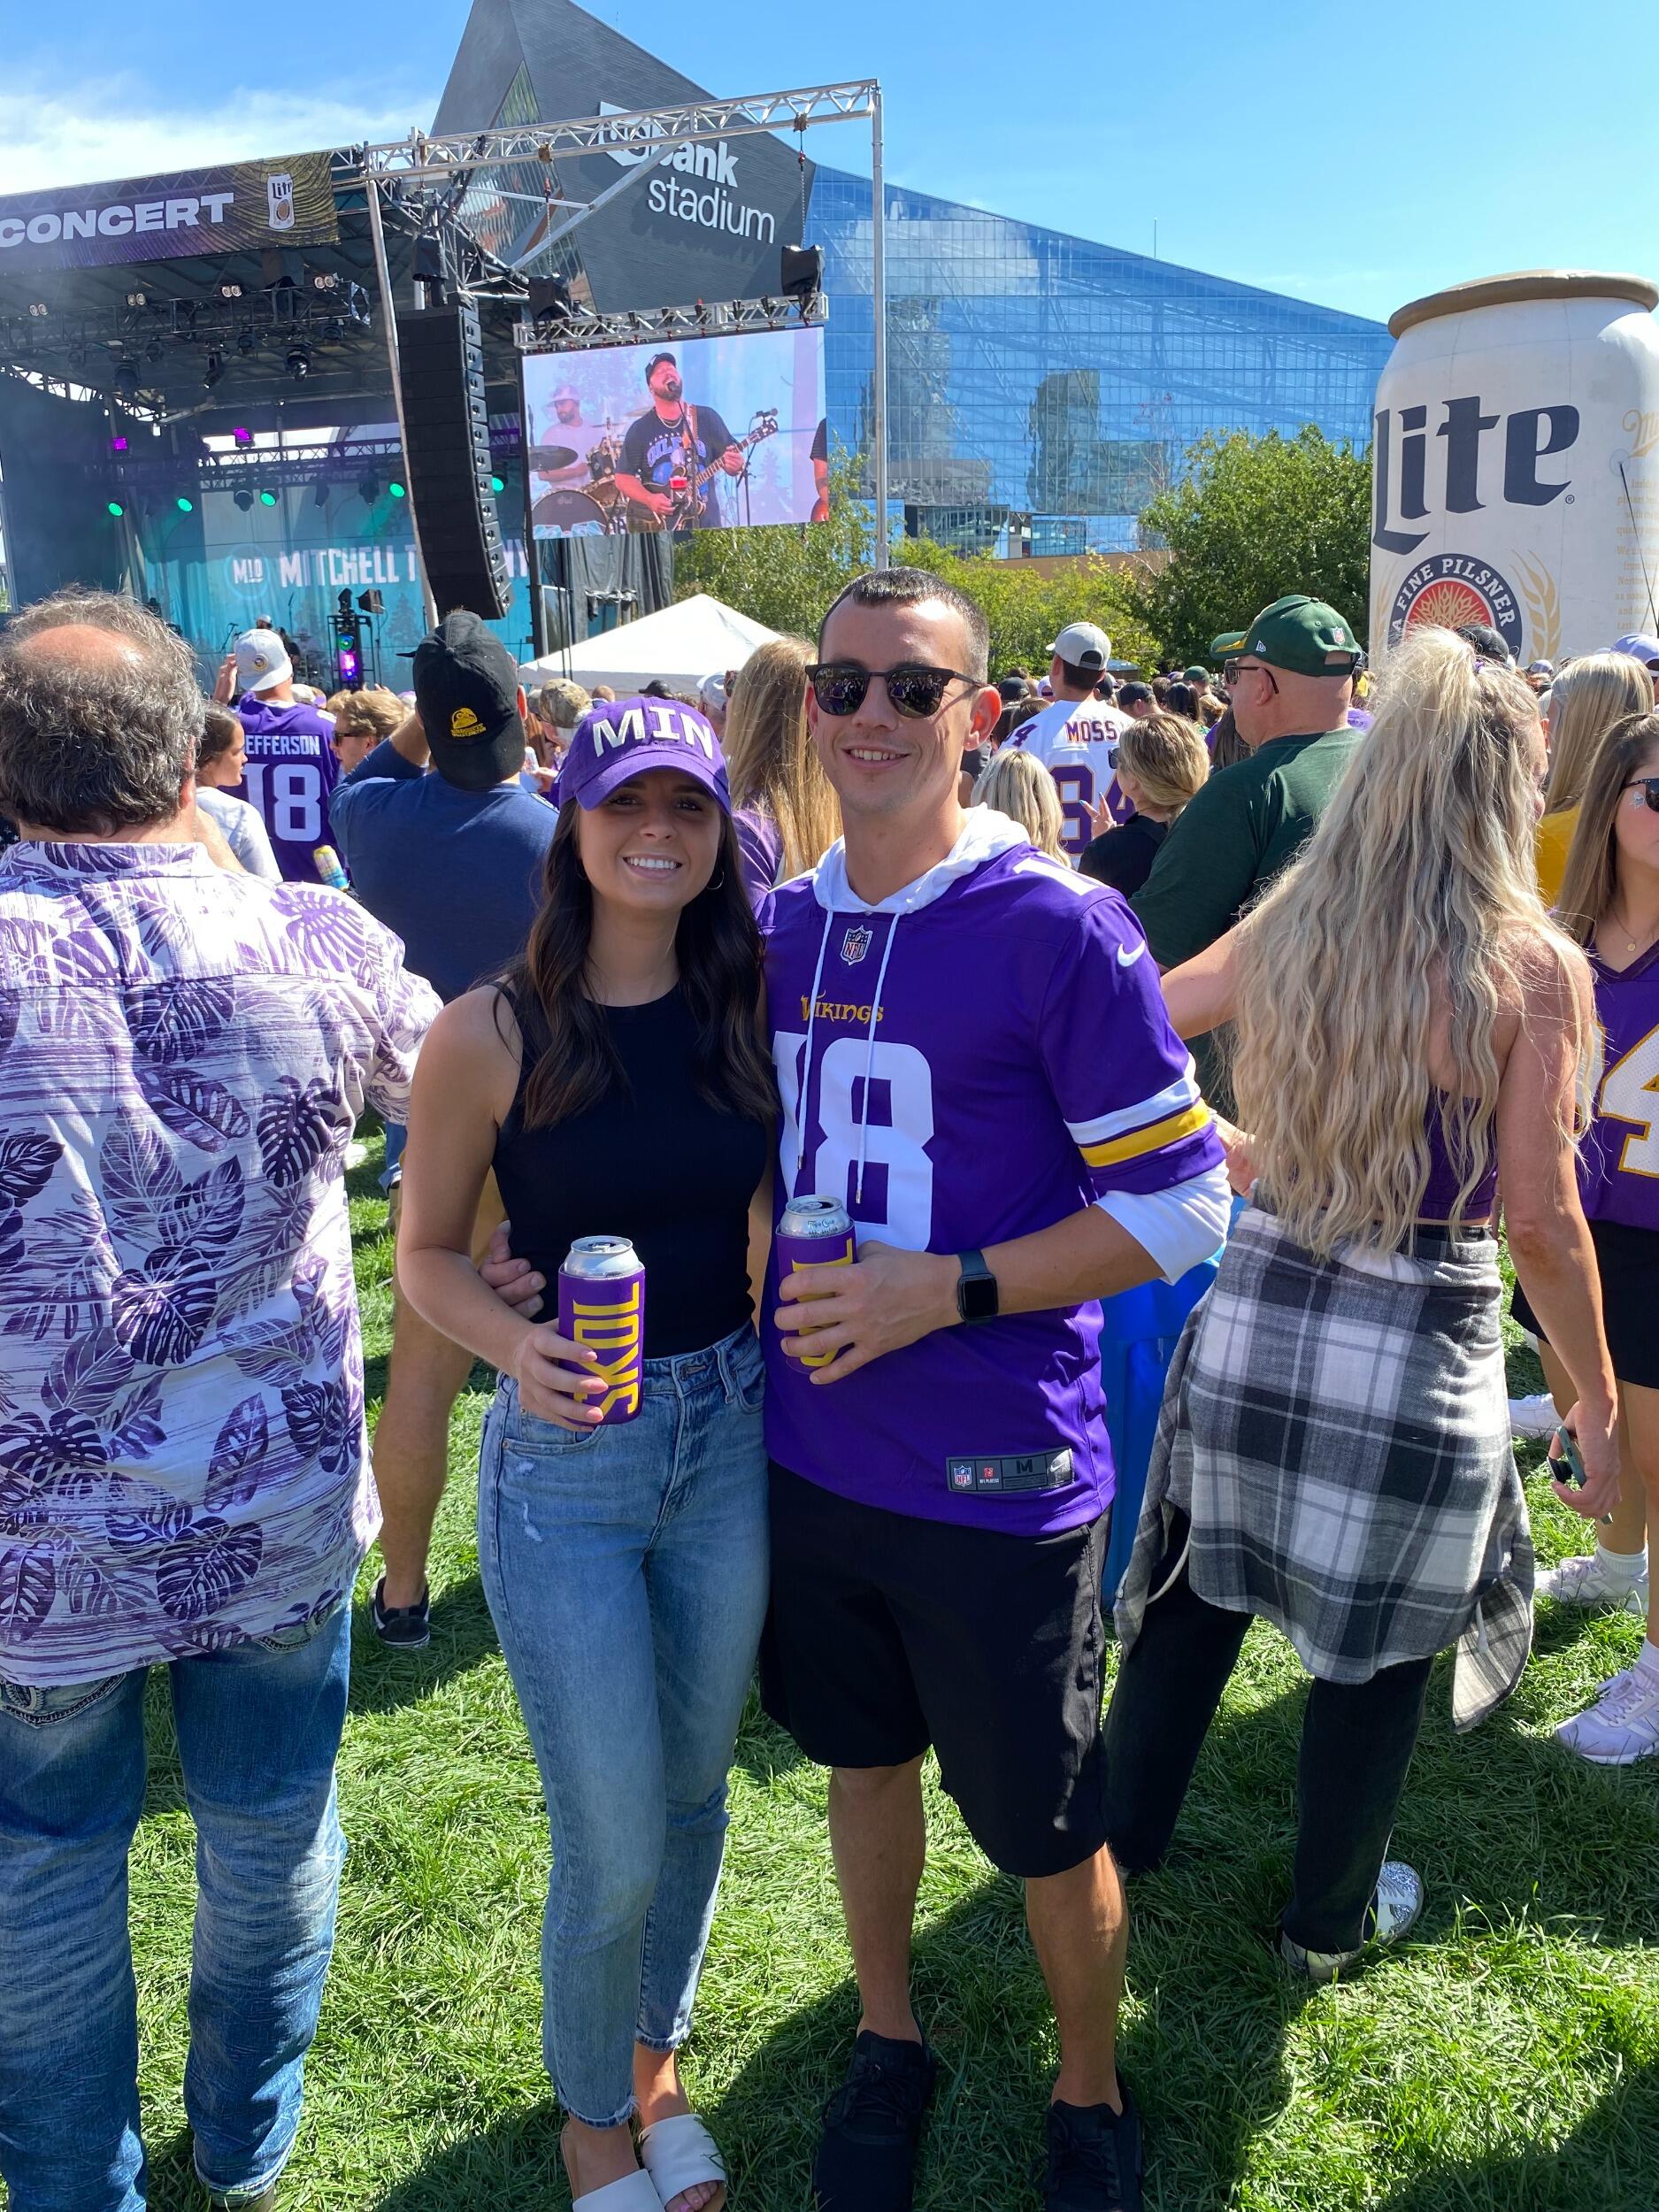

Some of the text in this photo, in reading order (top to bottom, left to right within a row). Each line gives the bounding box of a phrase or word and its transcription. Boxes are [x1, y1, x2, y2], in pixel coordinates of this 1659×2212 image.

[0, 192, 234, 248] CONCERT
[648, 176, 775, 244] stadium
[1372, 396, 1580, 555] Lite
[280, 545, 400, 588] MITCHELL
[1396, 564, 1434, 611] FINE
[1441, 558, 1516, 627] PILSNER
[243, 734, 320, 756] EFFERSON
[593, 706, 713, 760] MIN
[1064, 720, 1118, 743] MOSS
[242, 763, 322, 841] 18
[772, 1030, 934, 1253] 18
[573, 1280, 640, 1416] SKOL
[956, 1474, 971, 1484] NFL
[1016, 1458, 1033, 1474] M
